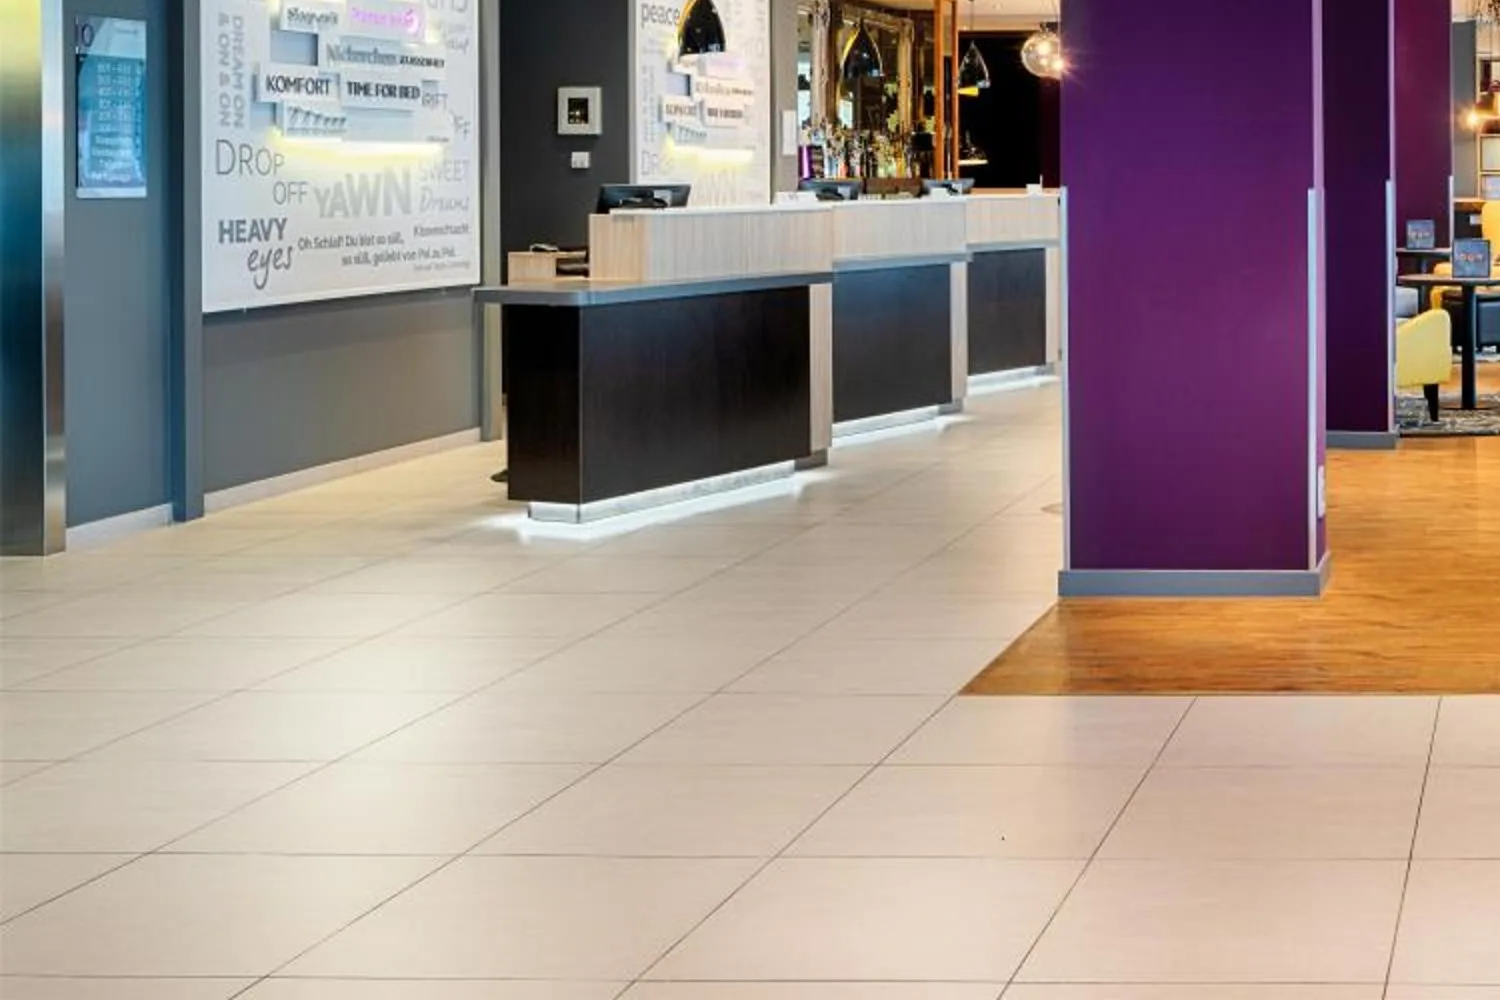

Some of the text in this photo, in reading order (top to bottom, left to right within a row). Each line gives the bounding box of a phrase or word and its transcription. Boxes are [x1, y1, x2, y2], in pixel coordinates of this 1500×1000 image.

[266, 75, 421, 100] KOMFORT TIME FOR BED
[233, 94, 246, 128] ON
[216, 139, 285, 177] DROP
[273, 181, 308, 206] OFF
[313, 166, 412, 219] YAWN
[218, 217, 287, 244] HEAVY
[297, 236, 312, 251] Oh
[345, 234, 358, 247] Du
[248, 246, 293, 290] eyes
